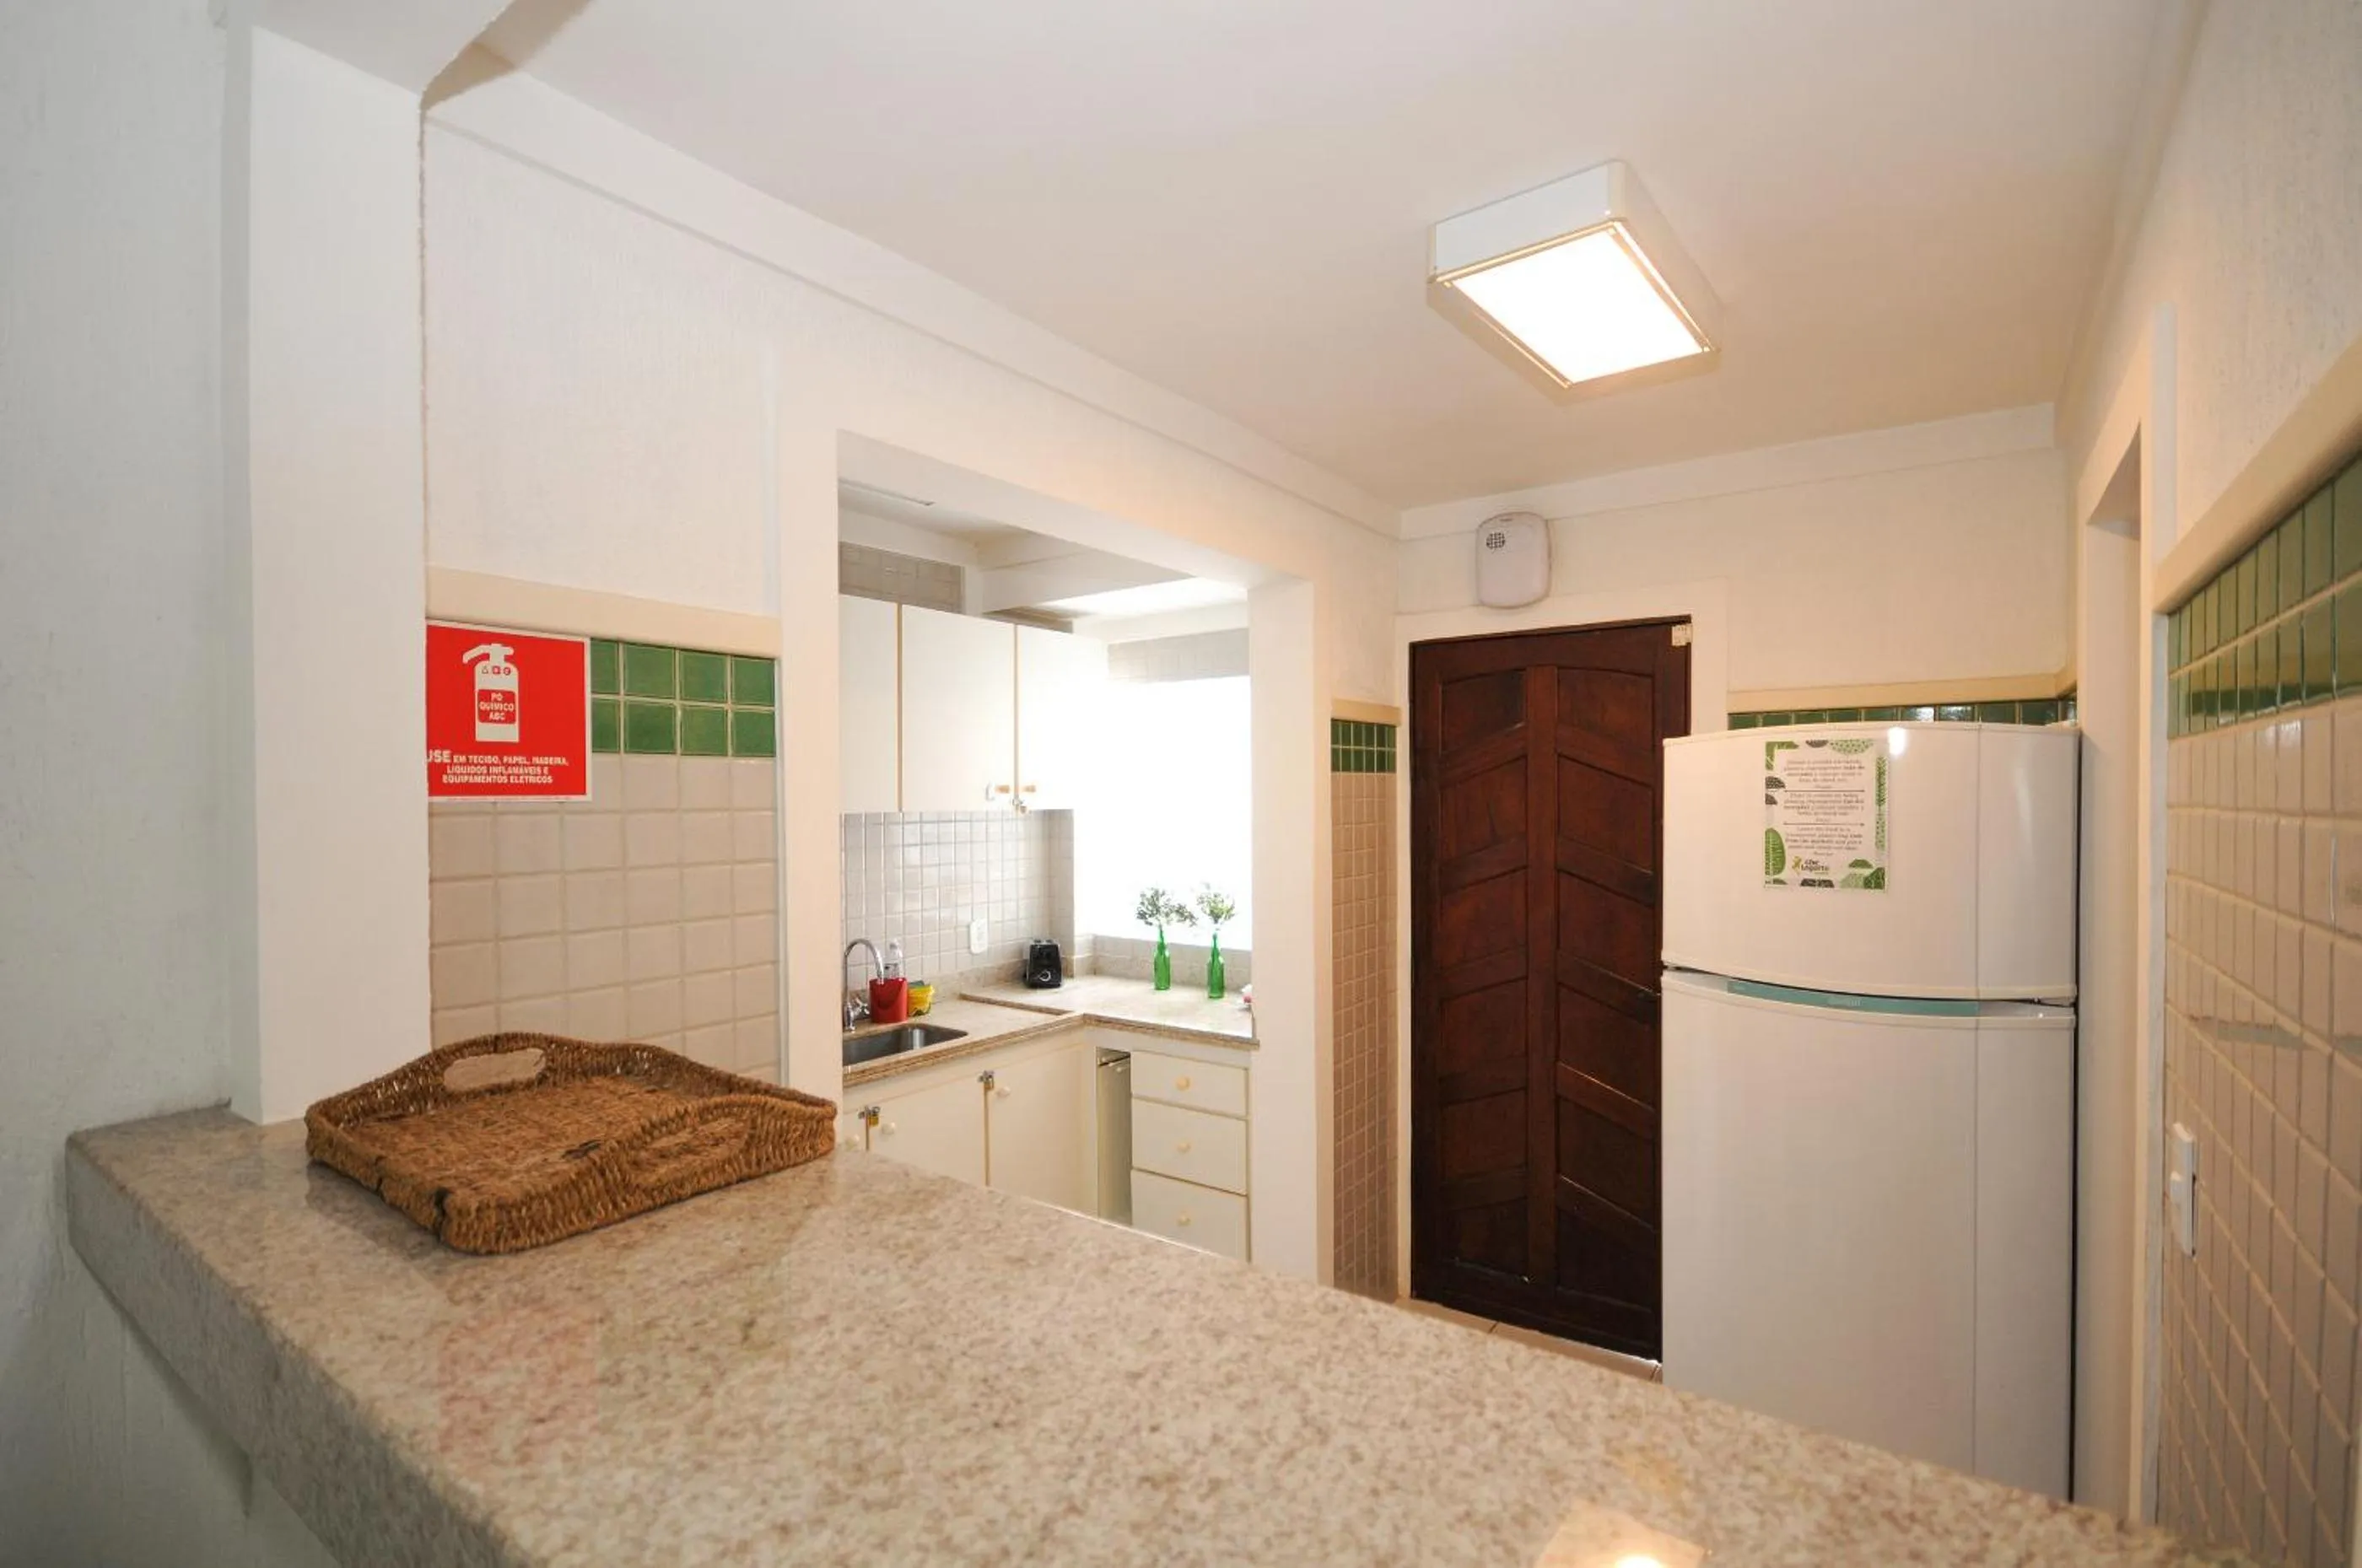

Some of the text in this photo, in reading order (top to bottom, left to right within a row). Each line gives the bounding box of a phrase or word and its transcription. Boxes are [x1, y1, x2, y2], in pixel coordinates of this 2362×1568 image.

[489, 712, 505, 720] ABC
[453, 755, 466, 763] EM
[542, 766, 549, 775] E
